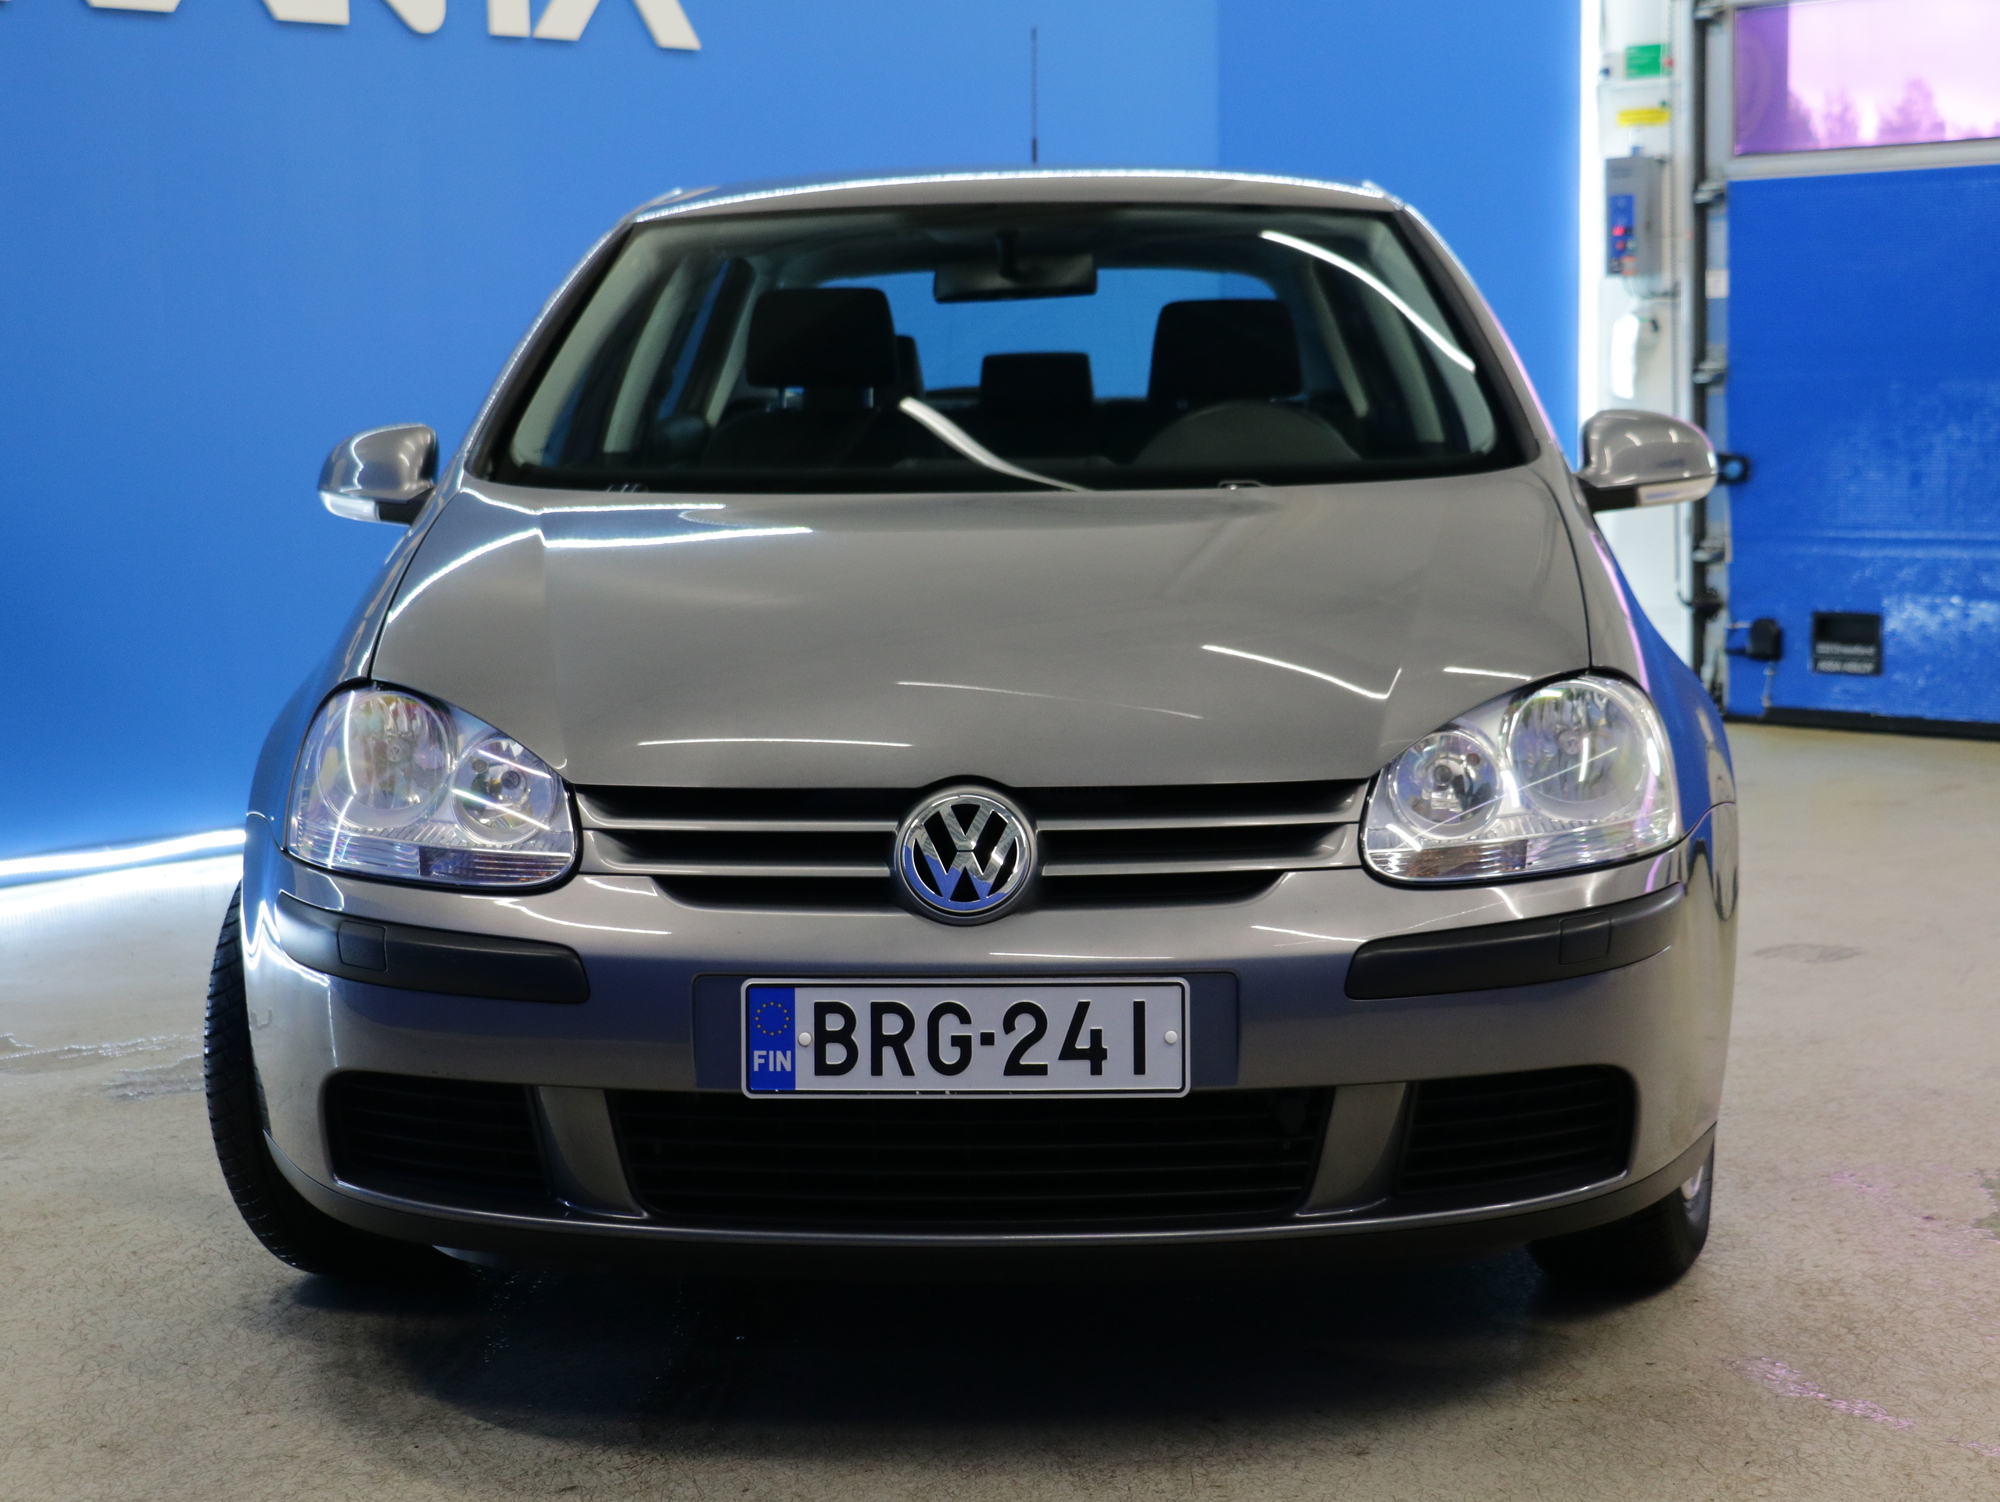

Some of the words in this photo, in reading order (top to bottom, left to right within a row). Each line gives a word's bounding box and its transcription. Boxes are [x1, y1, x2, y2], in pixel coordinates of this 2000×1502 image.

[904, 795, 1026, 910] VW
[753, 1050, 792, 1072] FIN
[813, 1000, 1147, 1077] BRG-241
